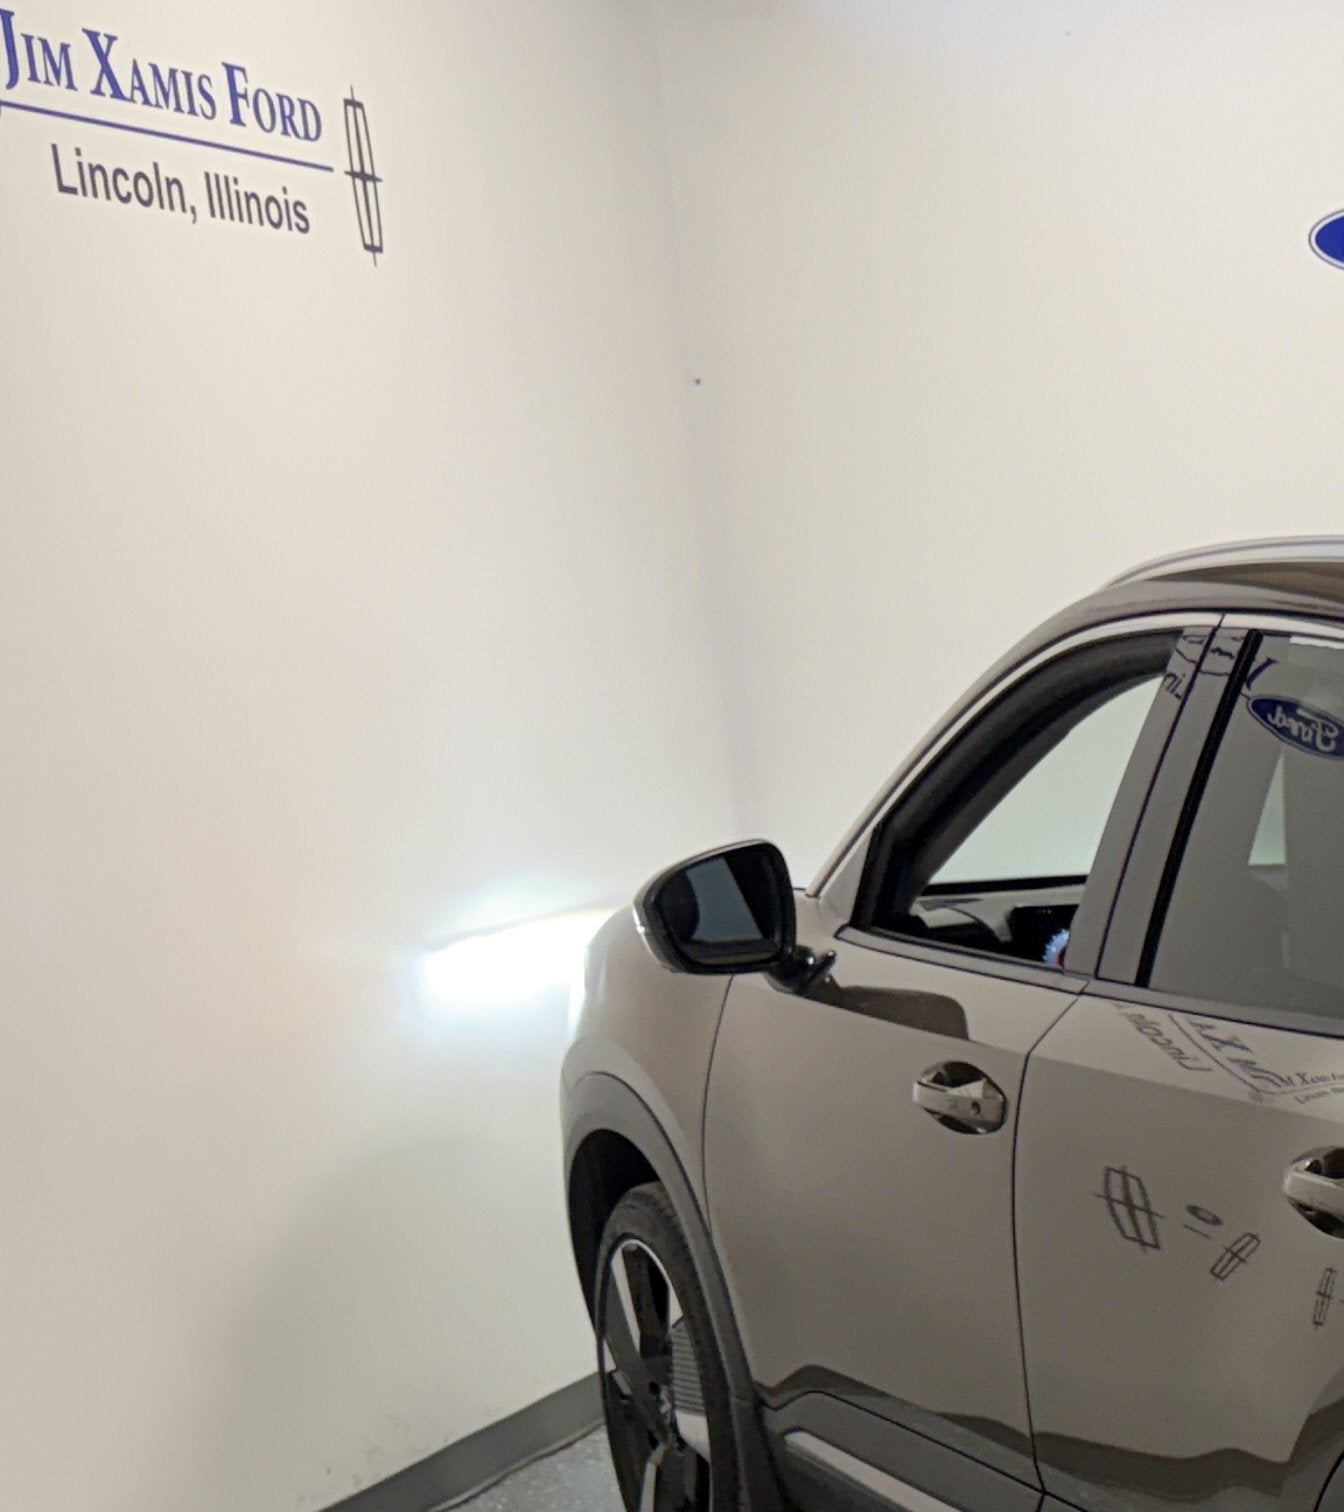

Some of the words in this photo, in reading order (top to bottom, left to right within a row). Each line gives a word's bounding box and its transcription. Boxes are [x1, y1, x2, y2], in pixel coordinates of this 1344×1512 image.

[0, 8, 78, 91] JIM
[81, 28, 217, 121] XAMIS
[223, 62, 323, 142] FORD
[51, 143, 197, 223] Lincoln,
[204, 171, 311, 234] Illinois
